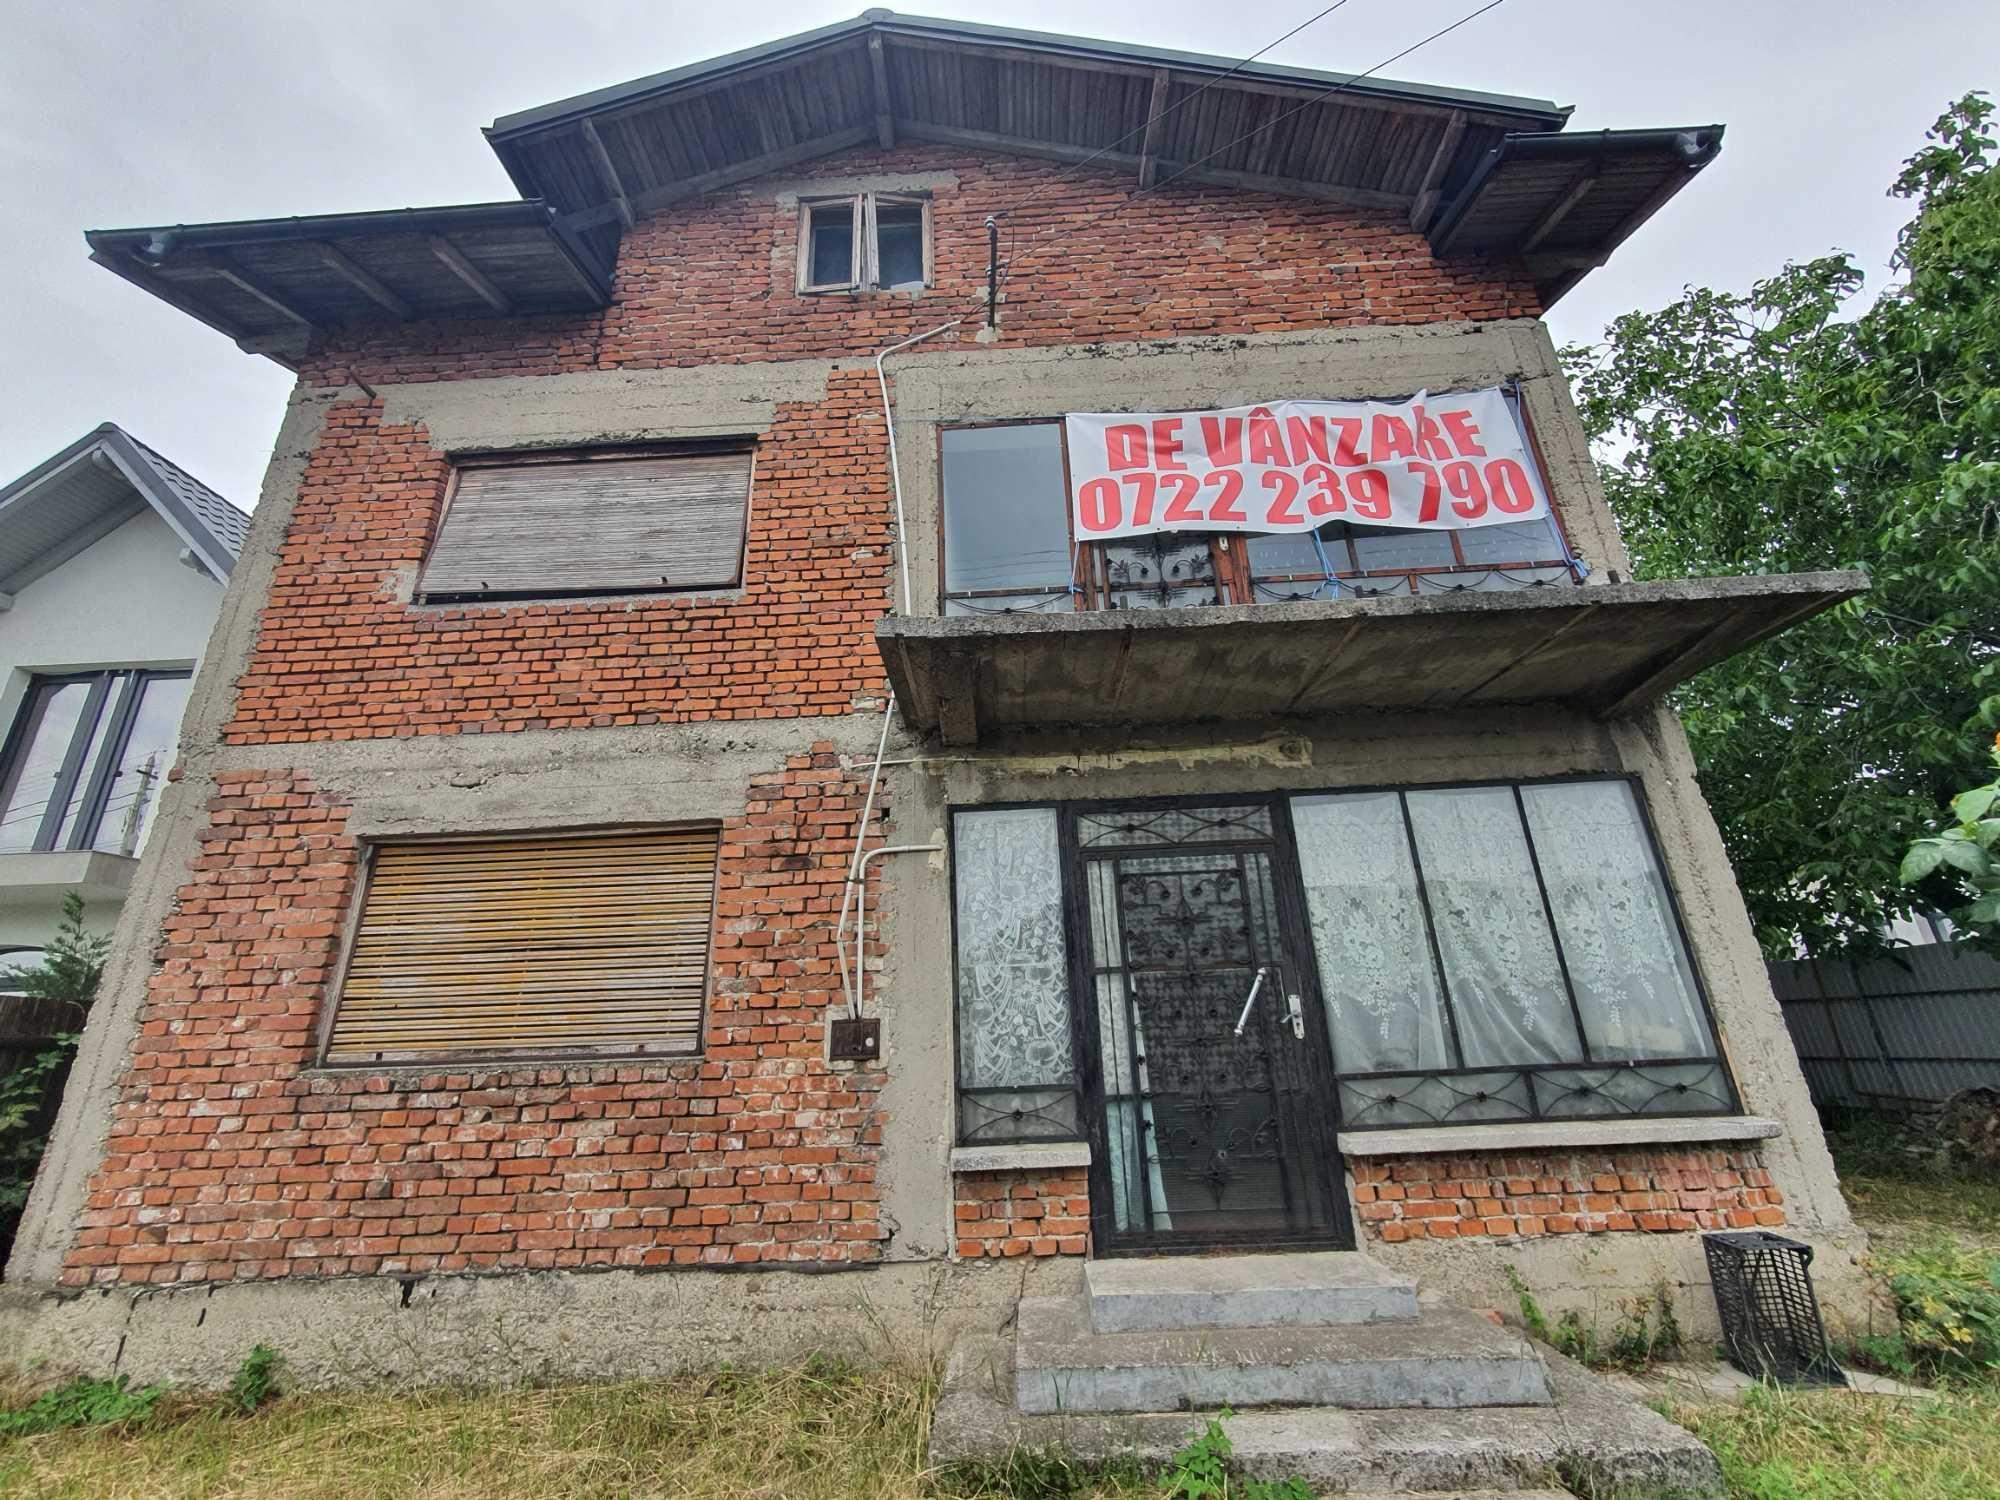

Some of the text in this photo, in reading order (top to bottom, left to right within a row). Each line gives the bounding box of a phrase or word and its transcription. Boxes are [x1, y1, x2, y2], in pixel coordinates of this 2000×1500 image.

[1105, 405, 1487, 471] DE VÂNZARE
[1079, 458, 1535, 532] 0722 239 790
